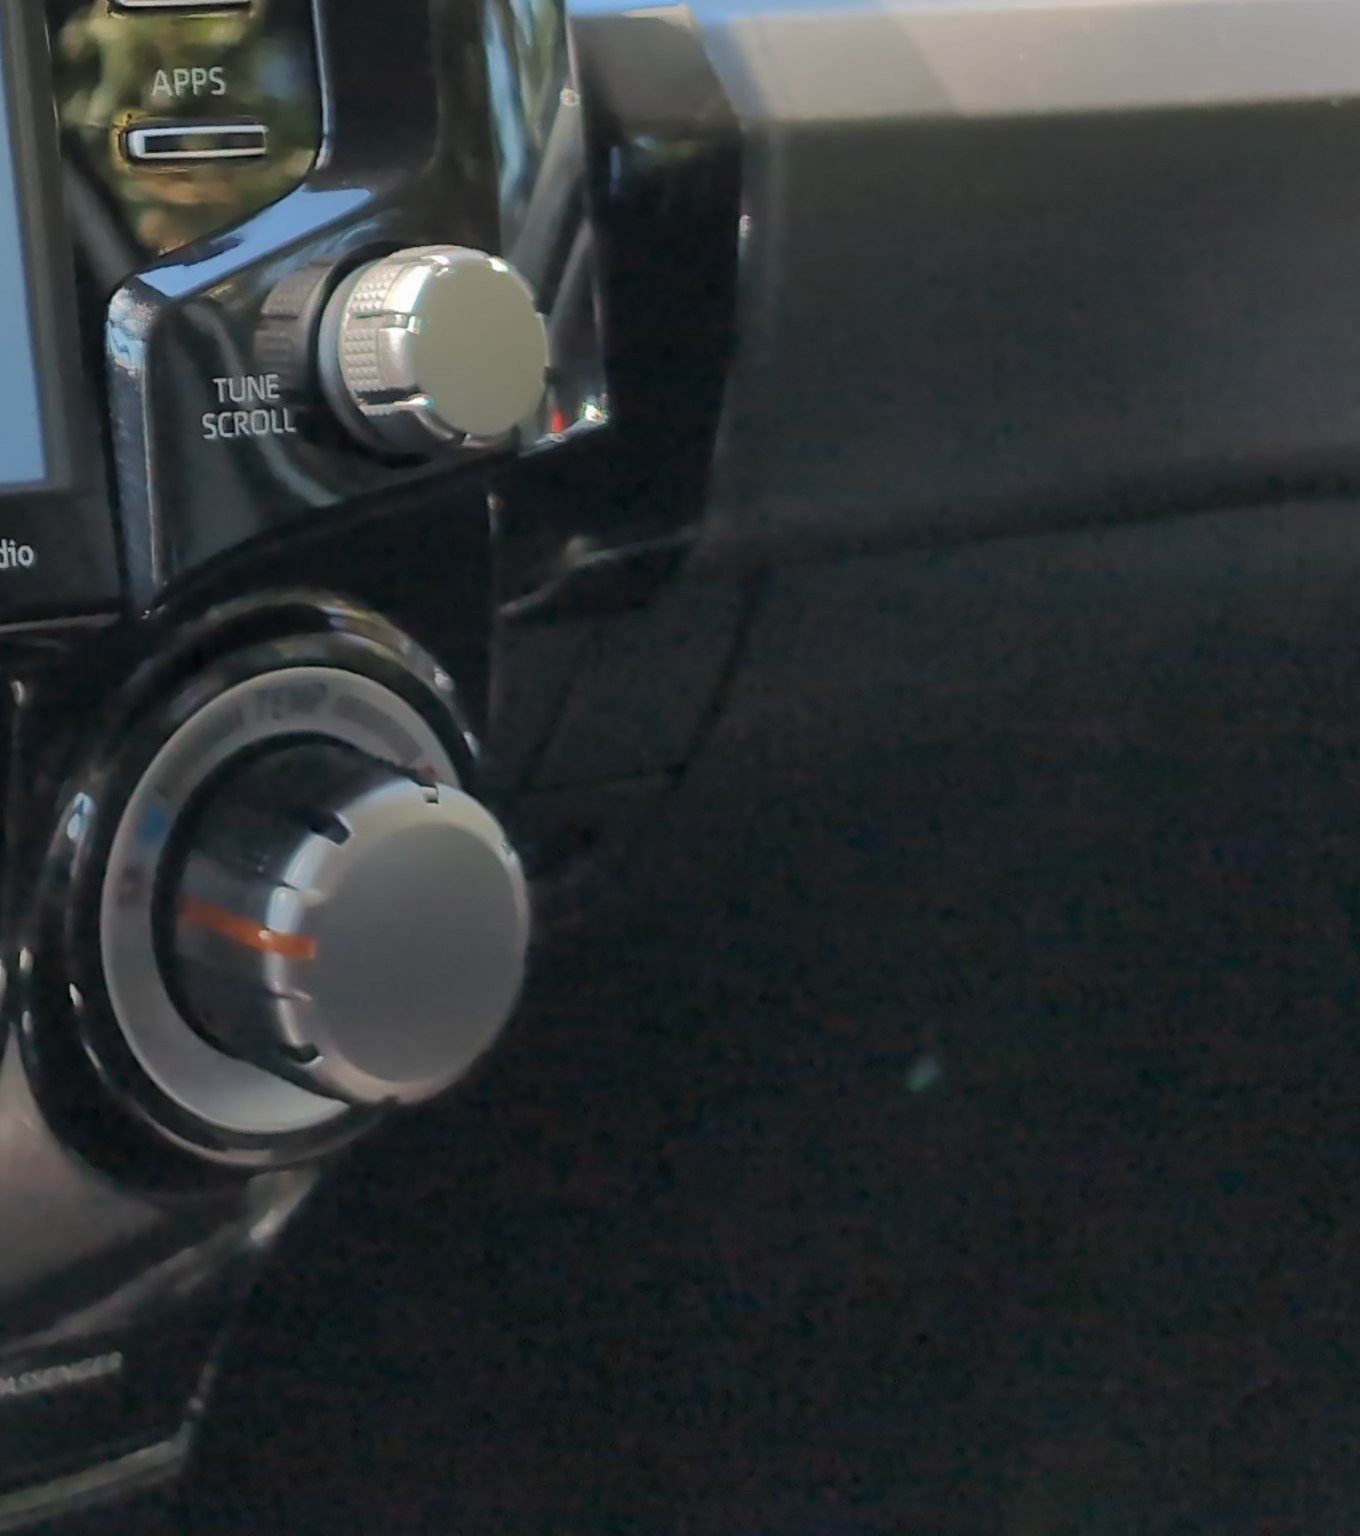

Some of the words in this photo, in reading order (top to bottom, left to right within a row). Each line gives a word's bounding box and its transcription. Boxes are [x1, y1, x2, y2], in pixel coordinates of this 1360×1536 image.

[151, 66, 227, 97] APPS
[212, 373, 281, 407] TUNE
[201, 405, 297, 441] SCROLL
